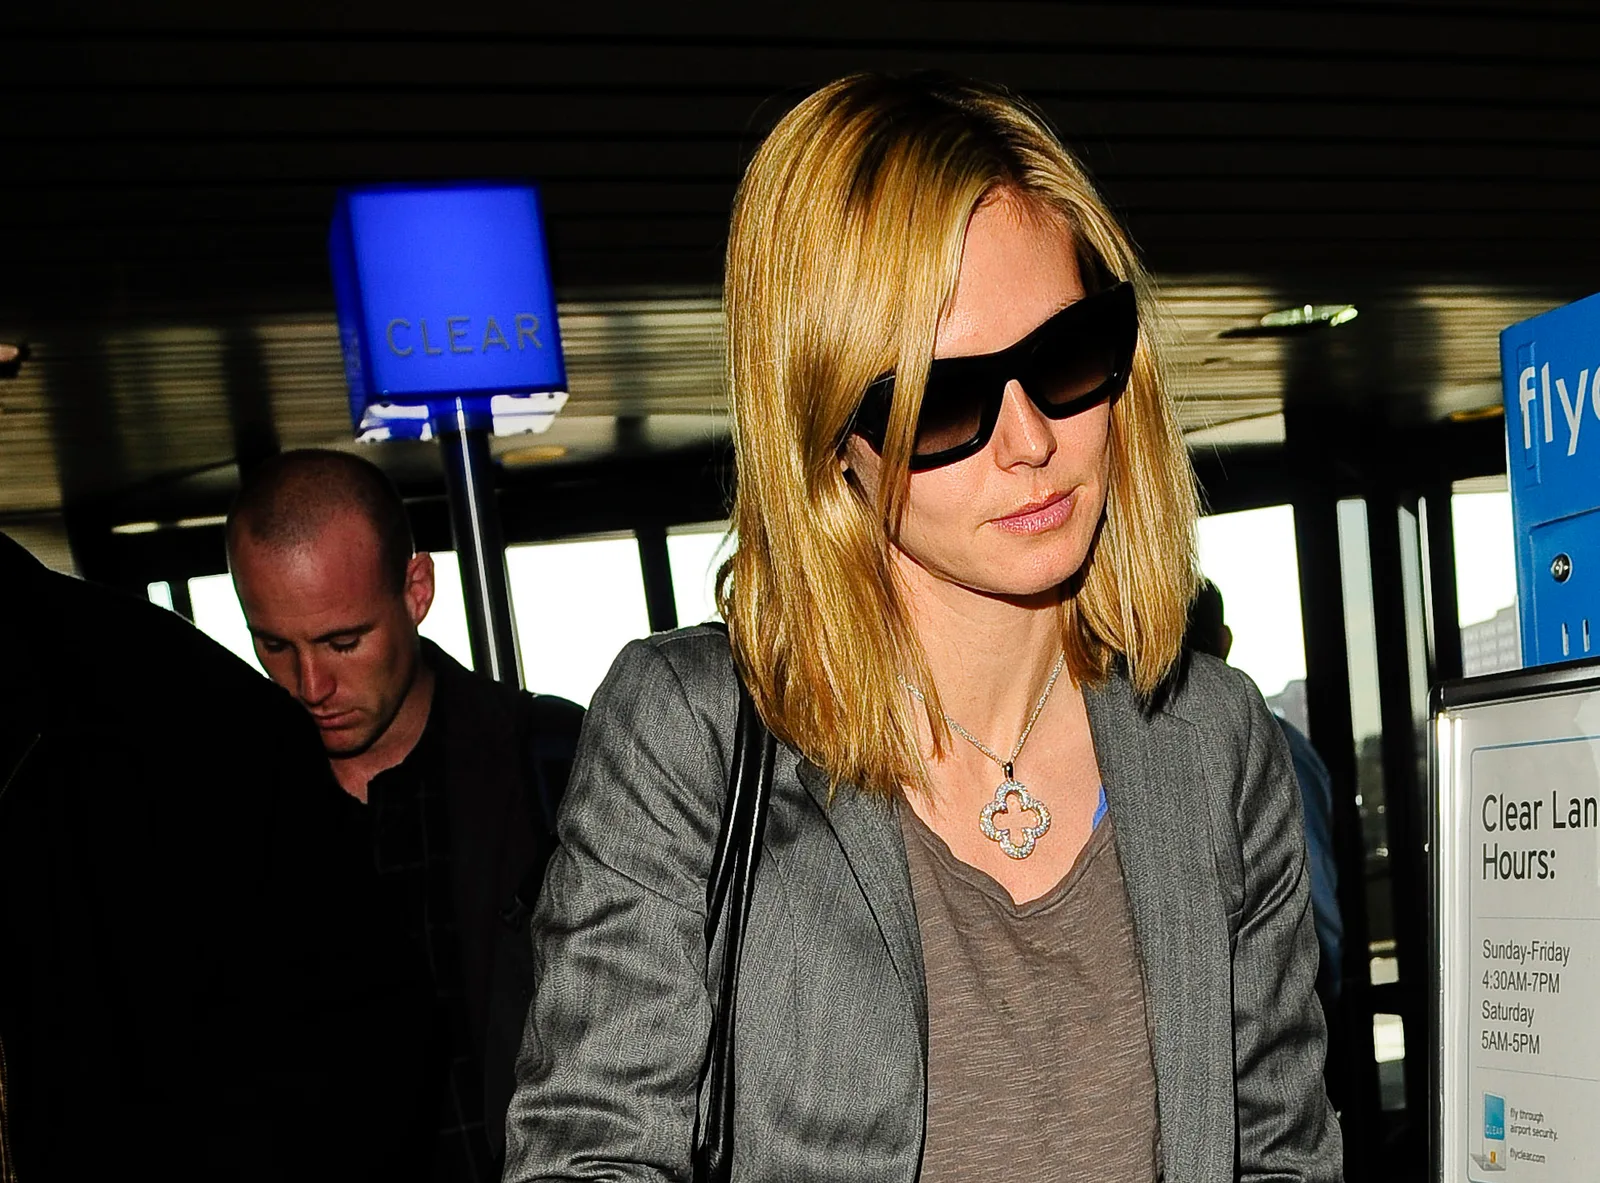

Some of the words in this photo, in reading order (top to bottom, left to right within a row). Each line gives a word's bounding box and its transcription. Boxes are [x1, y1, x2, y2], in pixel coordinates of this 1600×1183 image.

[386, 313, 543, 357] CLEAR
[1482, 793, 1543, 832] Clear
[1552, 790, 1598, 829] Lan
[1482, 842, 1556, 880] Hours:
[1482, 939, 1571, 967] Sunday-Friday
[1482, 970, 1560, 993] 4:30AM-7PM
[1482, 1000, 1535, 1028] Saturday
[1481, 1030, 1540, 1055] 5AM-5PM
